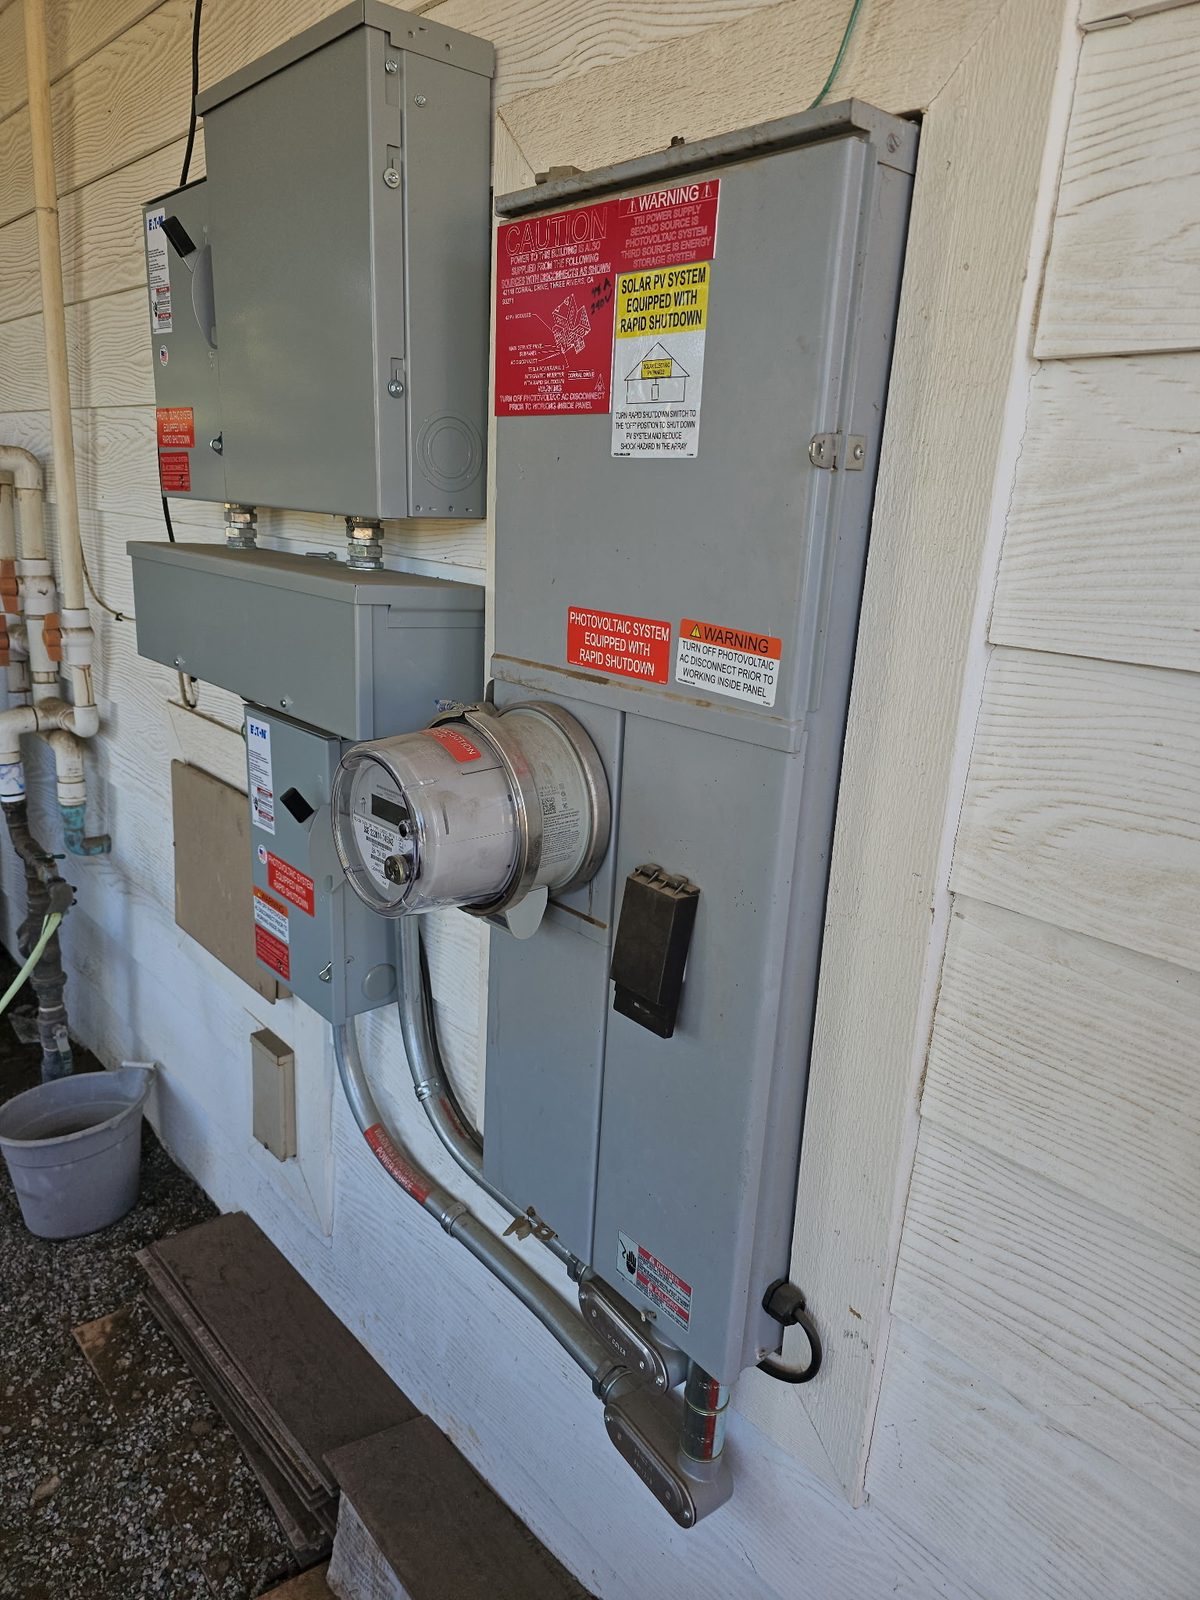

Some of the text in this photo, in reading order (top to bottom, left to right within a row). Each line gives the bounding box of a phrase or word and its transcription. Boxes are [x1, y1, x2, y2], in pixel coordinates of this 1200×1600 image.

[639, 185, 699, 212] WARNING
[630, 216, 699, 236] SECOND SOURCE IS
[633, 204, 702, 226] TRI POWER SUPPLY
[506, 207, 608, 256] CAUTION
[677, 226, 708, 239] SYSTEM
[510, 253, 530, 265] POWER
[584, 241, 601, 252] ALSO
[620, 236, 712, 259] THIRD SOURCE IS ENERGY
[633, 250, 697, 268] STORAGE SYSTEM
[537, 261, 553, 272] FROM
[554, 259, 565, 269] THE
[565, 253, 599, 266] FOLLOWING
[587, 276, 594, 284] CA
[621, 275, 652, 294] SOLAR
[653, 273, 666, 290] PV
[668, 267, 706, 288] SYSTEM
[626, 289, 698, 313] EQUIPPED WITH
[620, 309, 702, 333] RAPID SHUTDOWN
[615, 411, 628, 420] TURN
[642, 410, 669, 419] SHUTDOWN
[670, 409, 689, 418] SWITCH
[689, 409, 697, 418] TO
[615, 422, 624, 430] THE
[637, 421, 659, 429] POSITION
[659, 421, 666, 429] TO
[666, 420, 679, 429] SHUT
[680, 420, 696, 429] DOWN
[620, 442, 637, 450] SHOCK
[637, 442, 655, 450] HAZARD
[661, 442, 671, 450] THE
[670, 442, 688, 450] ARRAY
[625, 432, 633, 440] PV
[633, 432, 652, 440] SYSTEM
[662, 431, 682, 440] REDUCE
[569, 611, 670, 642] PHOTOVOLTAIC SYSTEM
[584, 631, 651, 657] EQUIPPED WITH
[703, 626, 769, 654] WARNING
[579, 648, 655, 677] RAPID SHUTDOWN
[682, 640, 775, 671] TURN OFF PHOTOVOLTAIC
[679, 653, 774, 685] AC DISCONNECT PRIOR TO
[682, 667, 716, 684] WORKING
[717, 676, 742, 691] INSIDE
[742, 683, 767, 698] PANEL
[376, 1146, 395, 1171] POWER
[656, 1261, 680, 1284] DANGER
[654, 1287, 679, 1311] PELIGRO
